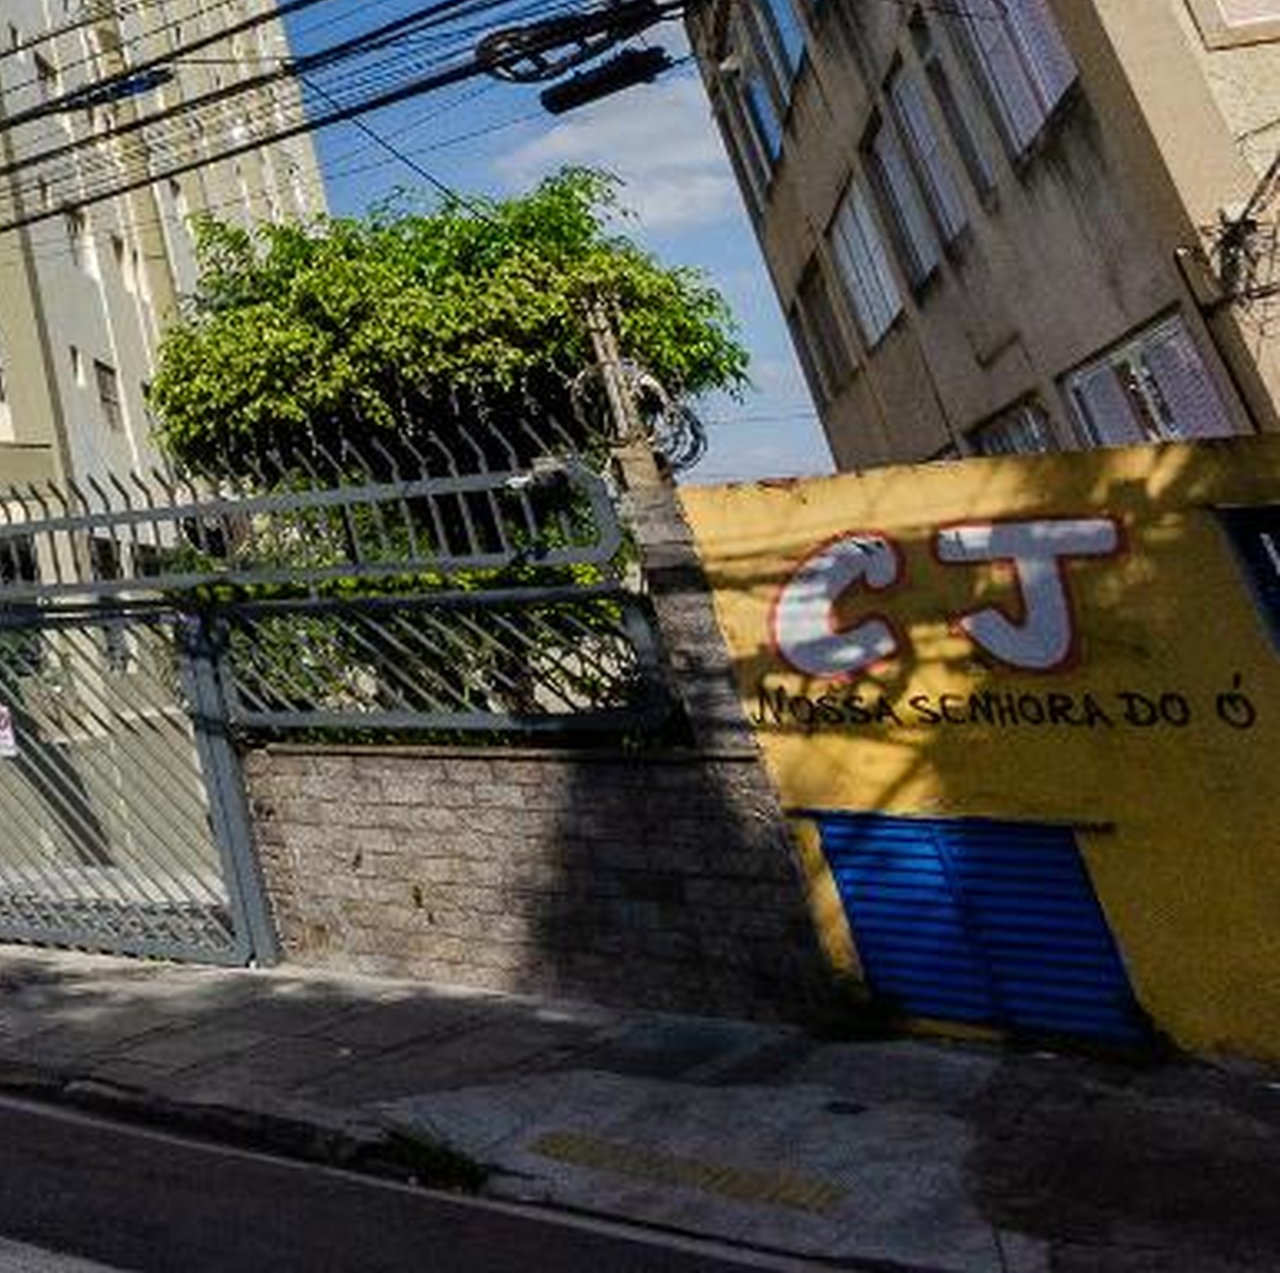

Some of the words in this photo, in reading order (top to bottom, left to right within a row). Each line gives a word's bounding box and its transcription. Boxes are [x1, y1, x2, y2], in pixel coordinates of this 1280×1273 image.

[751, 684, 904, 728] NOSSA
[908, 689, 1114, 728] SENHORA
[1116, 690, 1191, 728] DO
[1215, 671, 1257, 730] Ó
